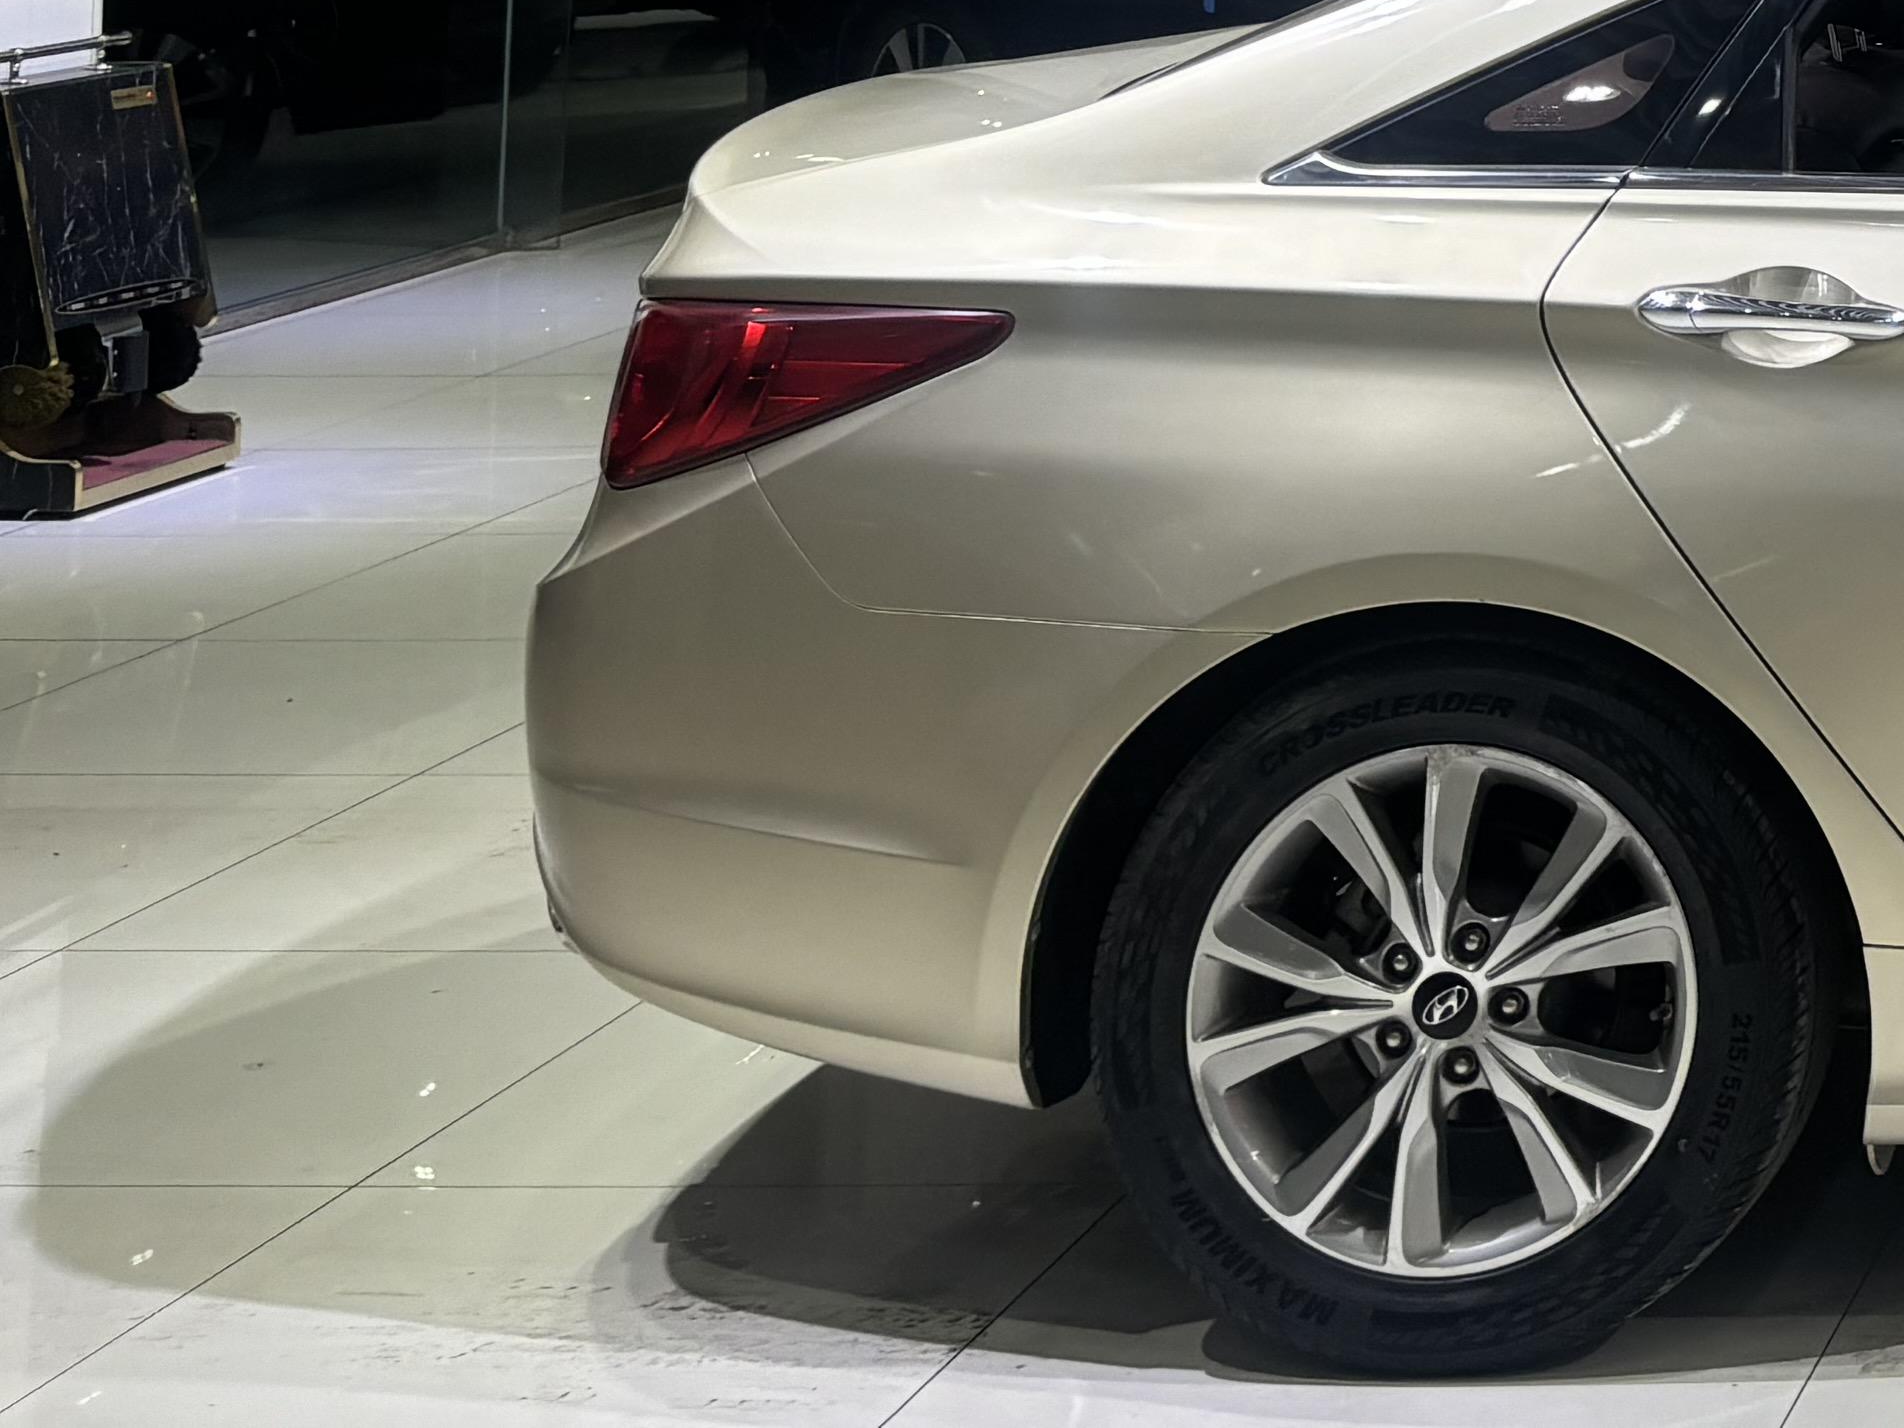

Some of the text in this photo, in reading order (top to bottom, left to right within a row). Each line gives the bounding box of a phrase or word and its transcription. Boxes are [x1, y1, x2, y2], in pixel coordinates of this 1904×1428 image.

[1259, 690, 1516, 775] CROSSLEADER
[1701, 1013, 1753, 1166] 215/55R17
[1170, 1186, 1338, 1326] MAXIMUM
